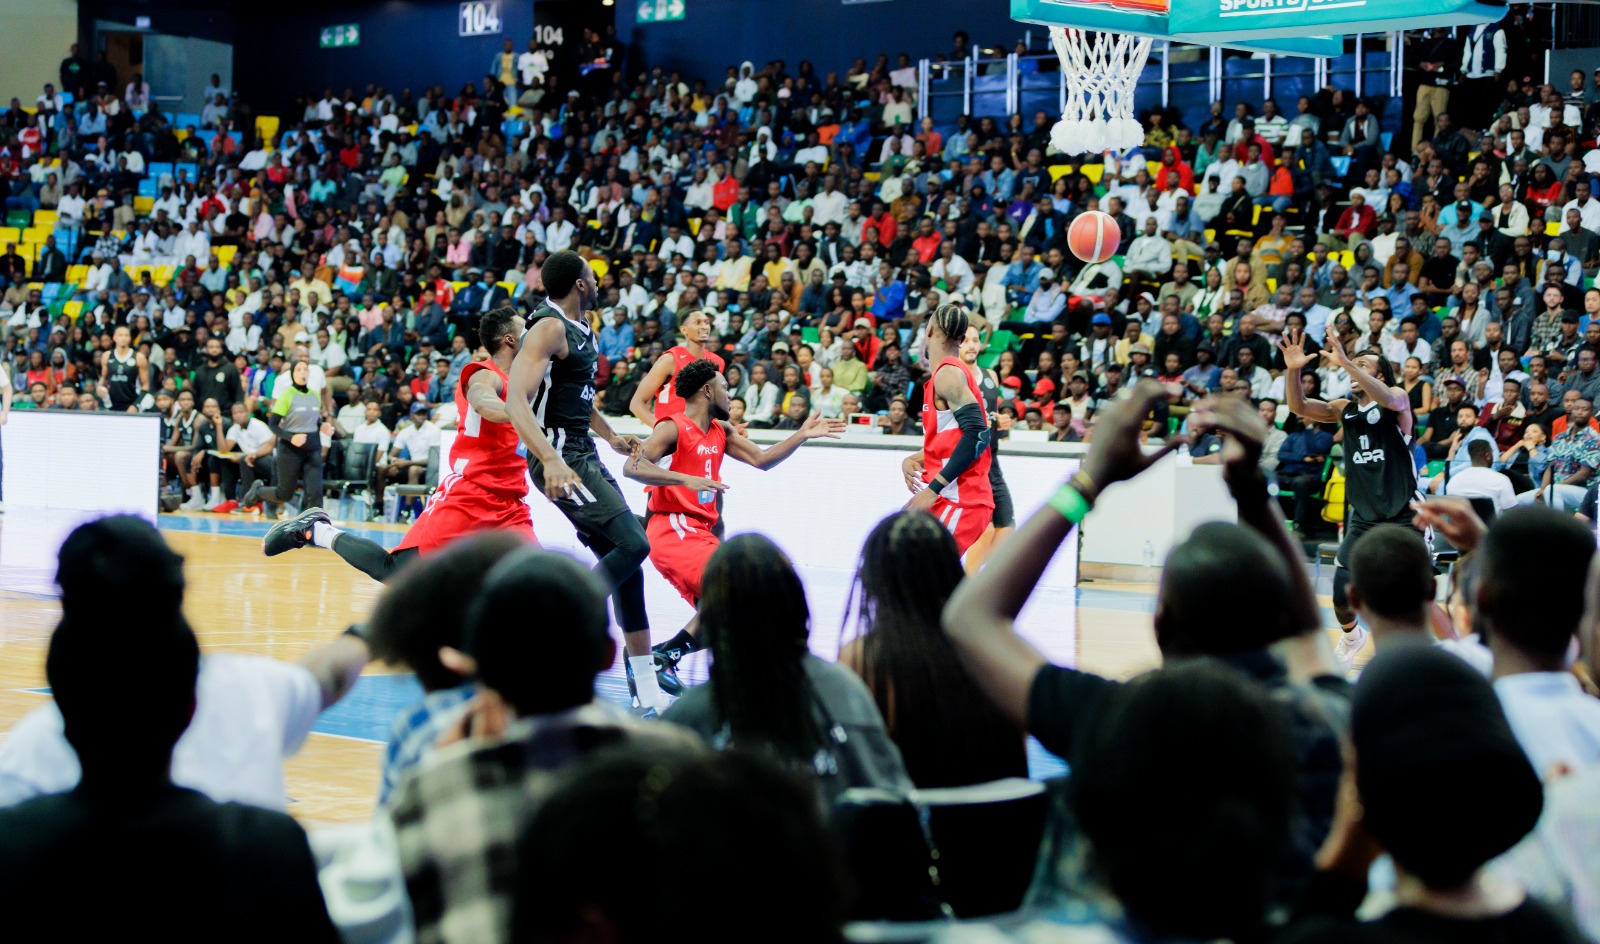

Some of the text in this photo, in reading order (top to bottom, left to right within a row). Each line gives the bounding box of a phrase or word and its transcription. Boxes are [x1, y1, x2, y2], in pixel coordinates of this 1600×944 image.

[463, 2, 499, 33] 104
[534, 24, 563, 45] 104
[1353, 449, 1385, 464] APR
[705, 459, 712, 480] 9
